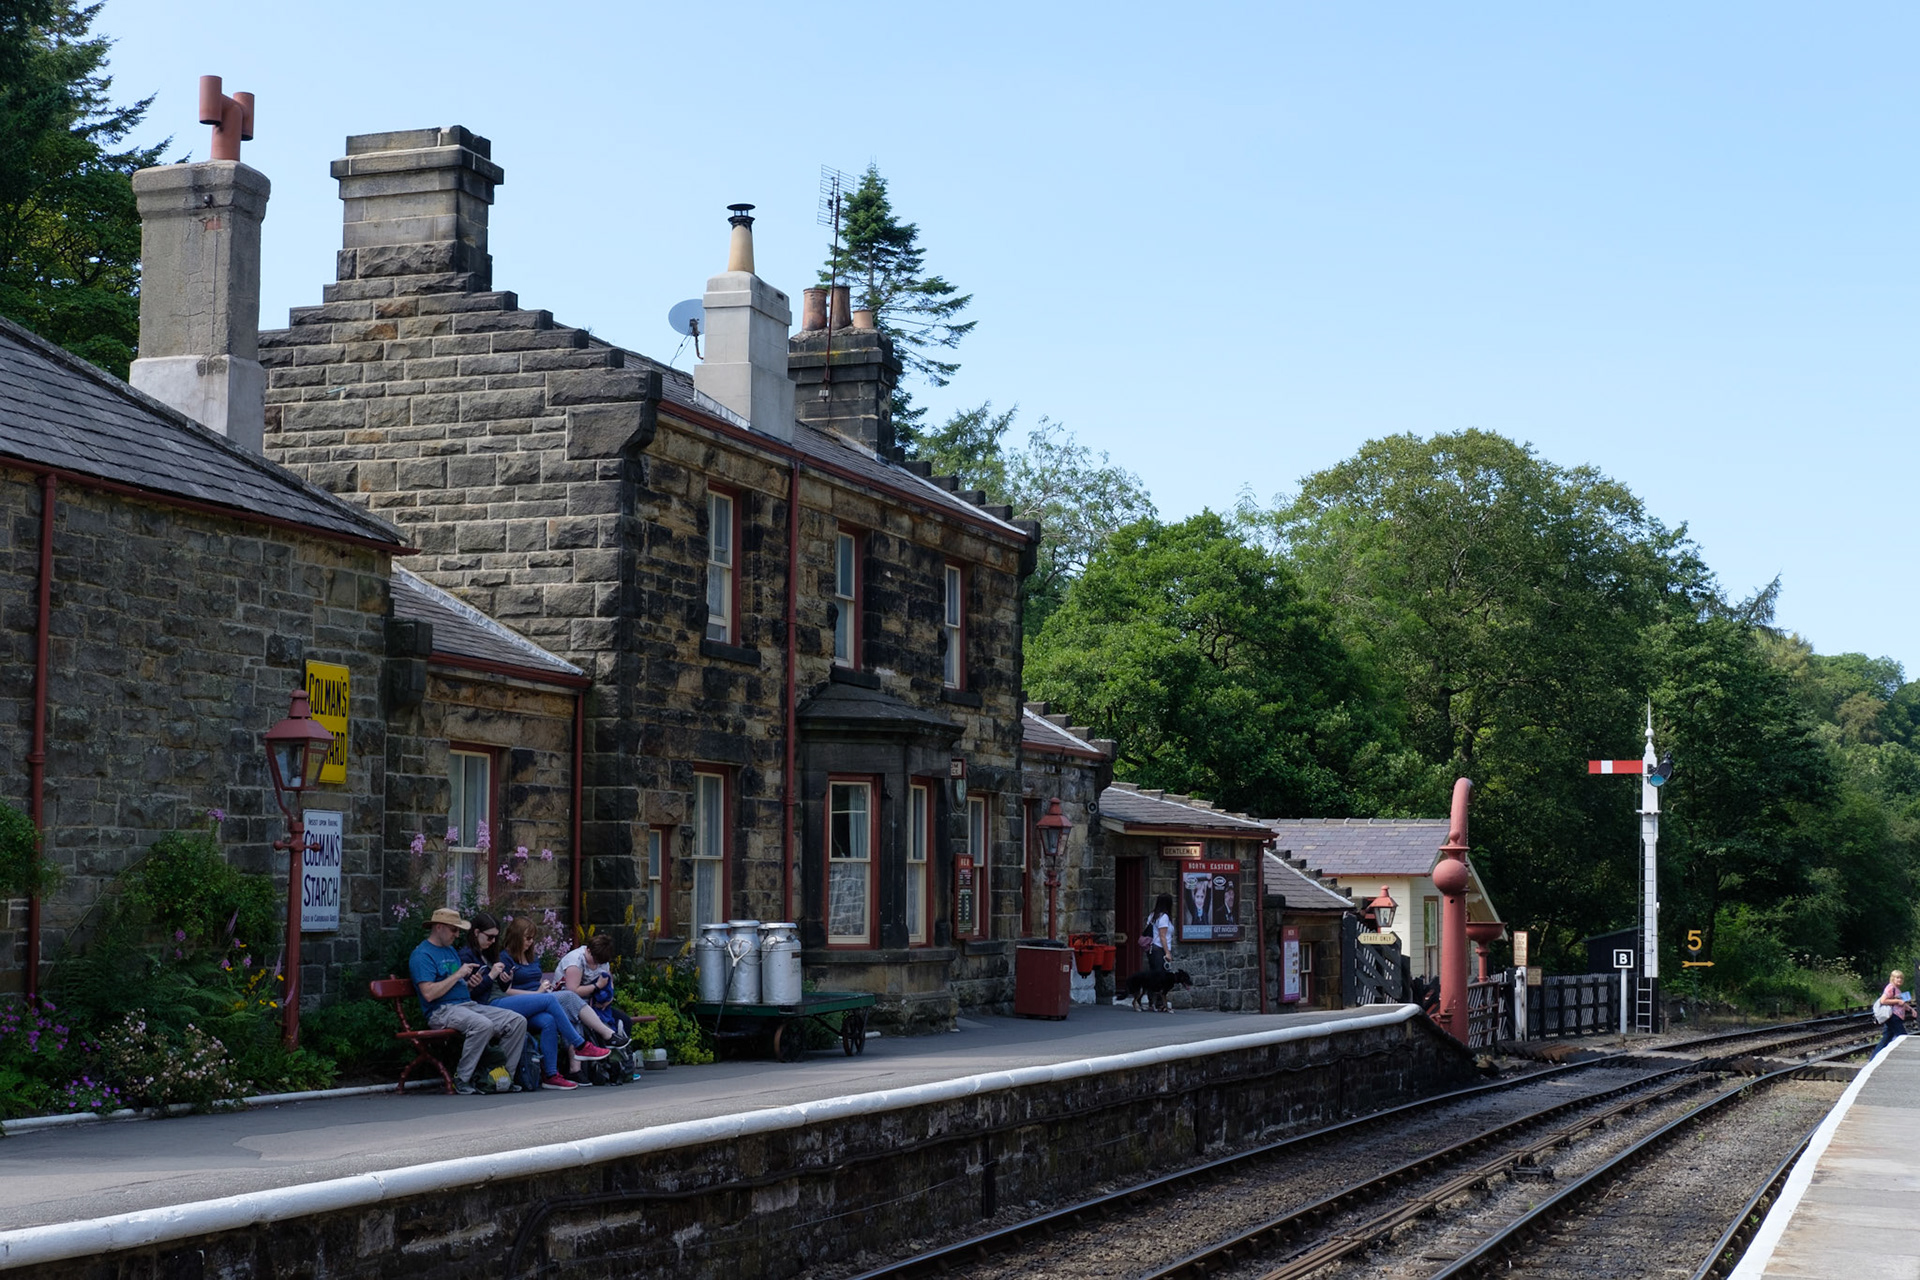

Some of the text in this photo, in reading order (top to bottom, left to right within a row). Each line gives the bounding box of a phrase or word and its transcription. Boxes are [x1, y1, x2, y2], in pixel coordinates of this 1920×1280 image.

[308, 672, 347, 718] COLMAN'S
[304, 829, 340, 867] COLMAN'S
[1164, 847, 1198, 855] GENTLEMEN
[1188, 862, 1206, 870] NORTH
[304, 873, 339, 907] STARCH
[1687, 930, 1702, 951] 5
[1619, 953, 1628, 965] B
